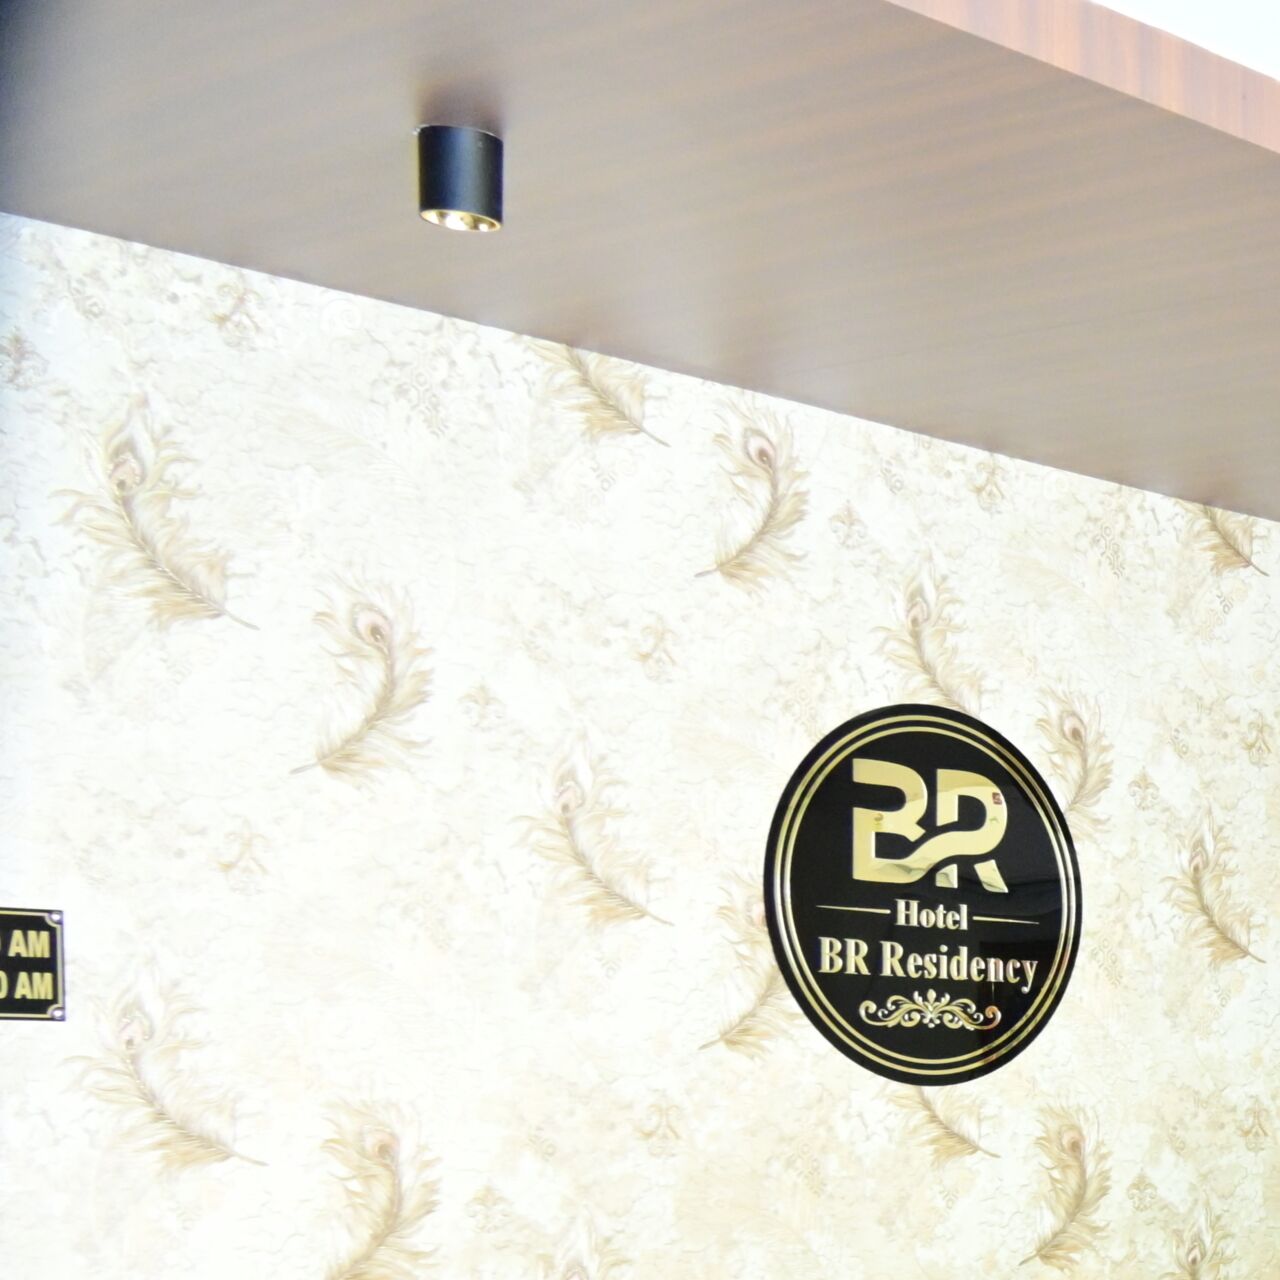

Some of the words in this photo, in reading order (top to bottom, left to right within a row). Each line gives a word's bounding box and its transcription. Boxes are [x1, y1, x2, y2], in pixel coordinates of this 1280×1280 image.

[895, 898, 969, 931] Hotel
[8, 929, 51, 958] AM
[818, 936, 871, 976] BR
[879, 940, 1039, 994] Residency
[14, 971, 54, 1000] AM
